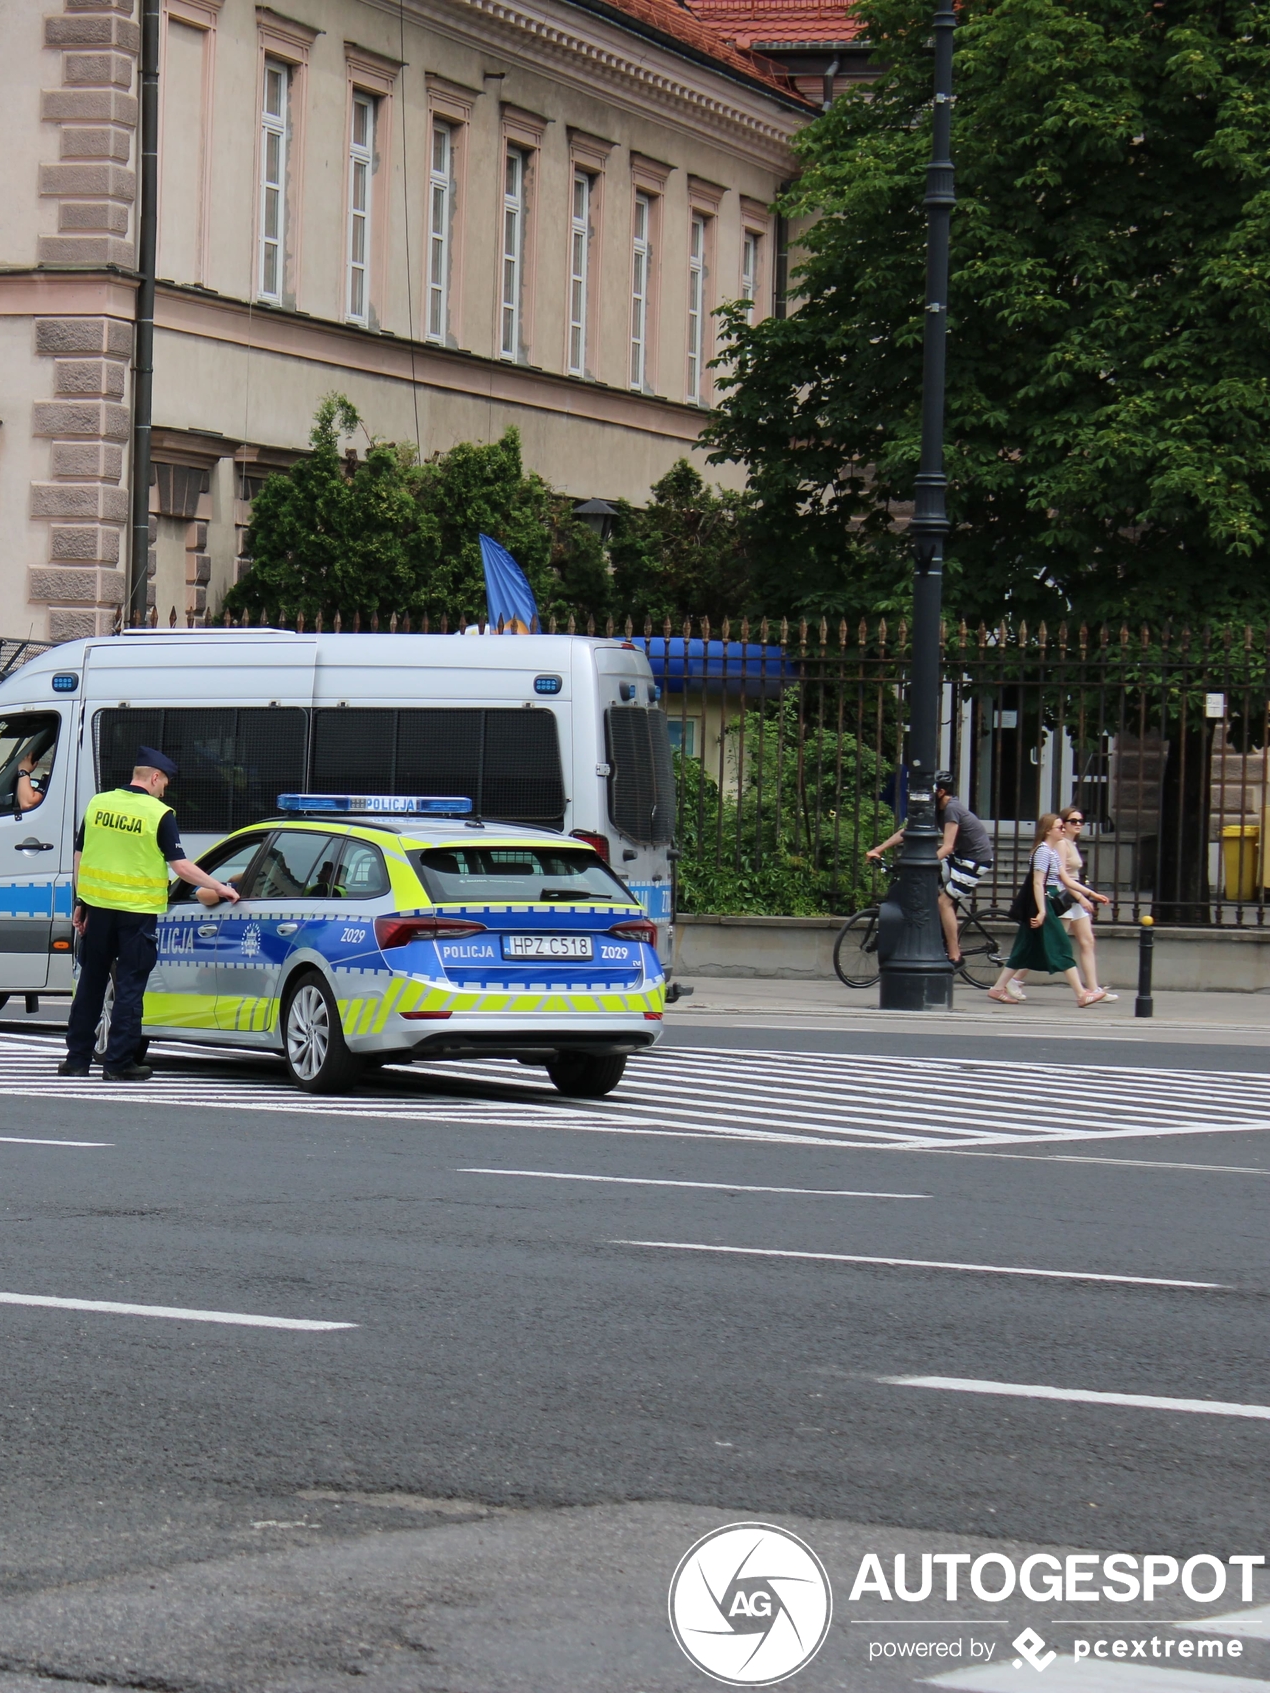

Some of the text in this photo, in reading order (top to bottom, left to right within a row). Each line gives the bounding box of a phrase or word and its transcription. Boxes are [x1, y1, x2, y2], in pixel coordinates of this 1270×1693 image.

[366, 797, 415, 811] POLICJA
[95, 811, 143, 834] POLICJA
[340, 927, 366, 944] Z029
[443, 945, 495, 958] POLICJA
[513, 937, 588, 955] HPZ C518
[601, 945, 628, 960] Z029
